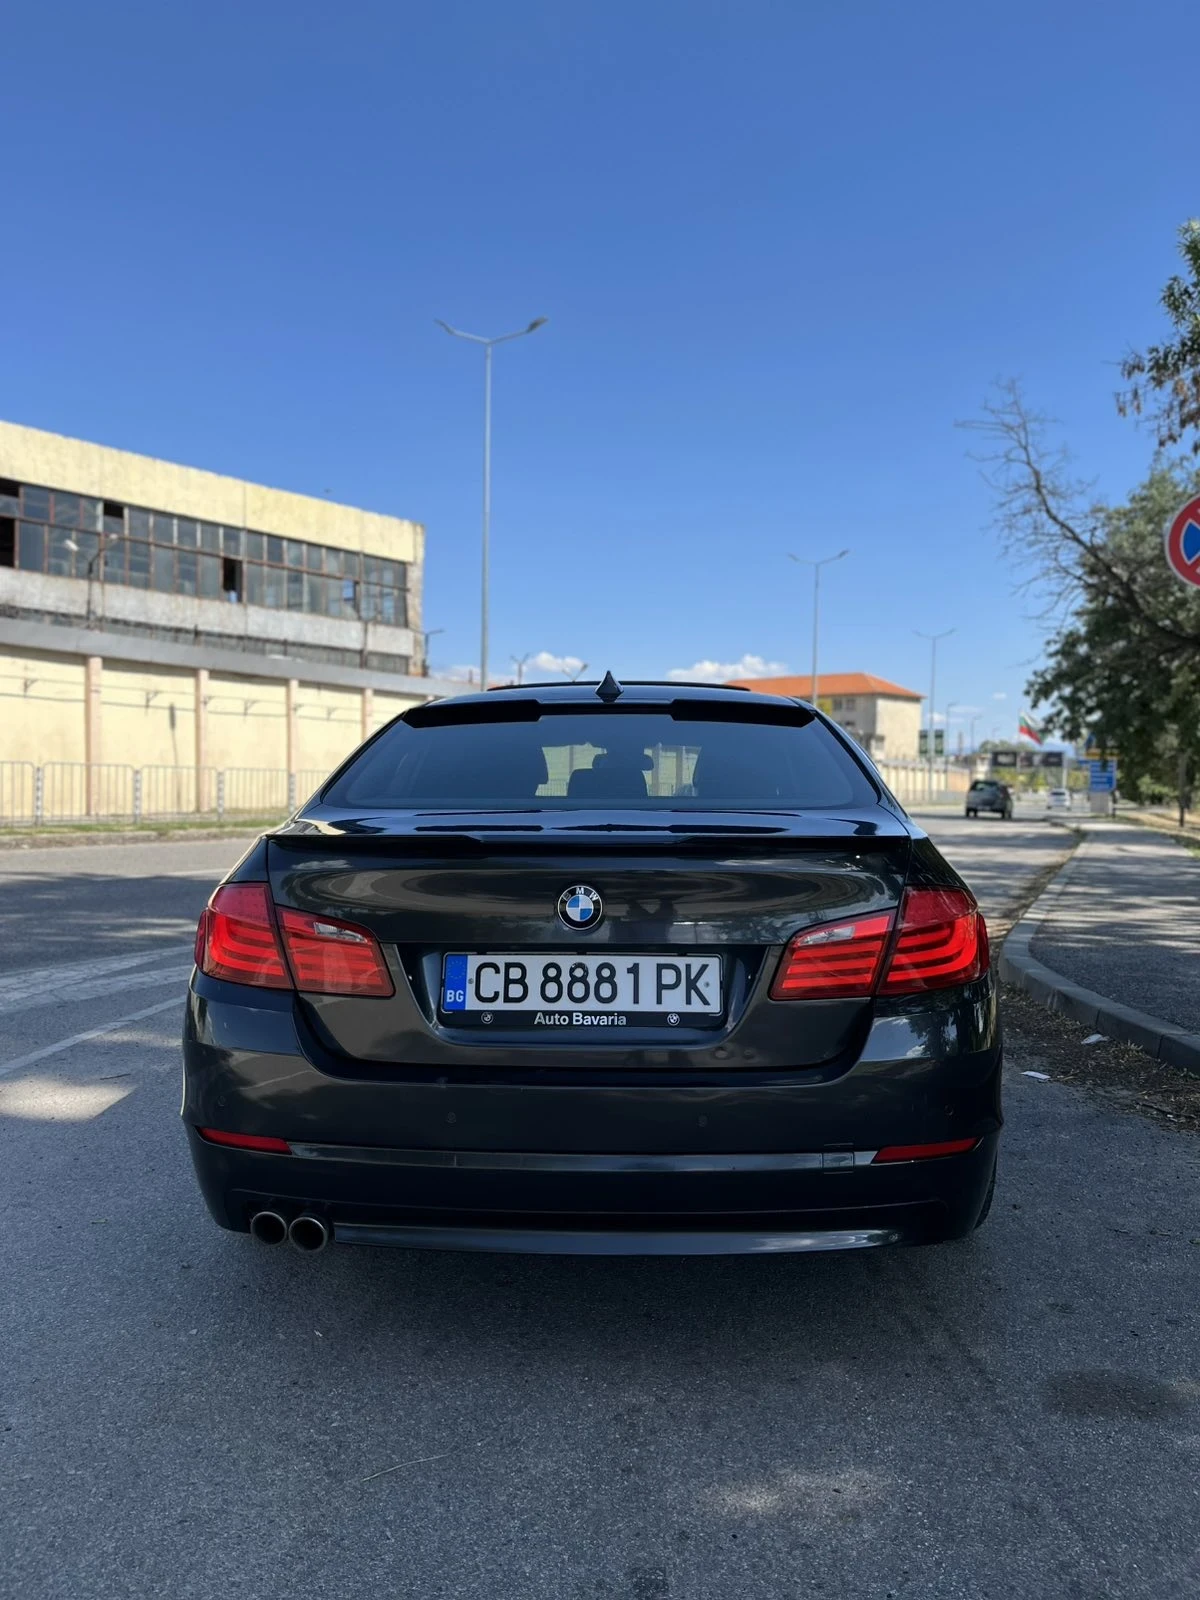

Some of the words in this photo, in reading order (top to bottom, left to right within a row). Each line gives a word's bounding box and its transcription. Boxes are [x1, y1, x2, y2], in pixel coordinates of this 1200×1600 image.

[474, 961, 529, 1004] CB
[540, 962, 640, 1005] 8881
[656, 963, 711, 1006] PK
[446, 990, 464, 1002] BG
[534, 1012, 569, 1025] Auto
[572, 1013, 627, 1026] Bavaria
